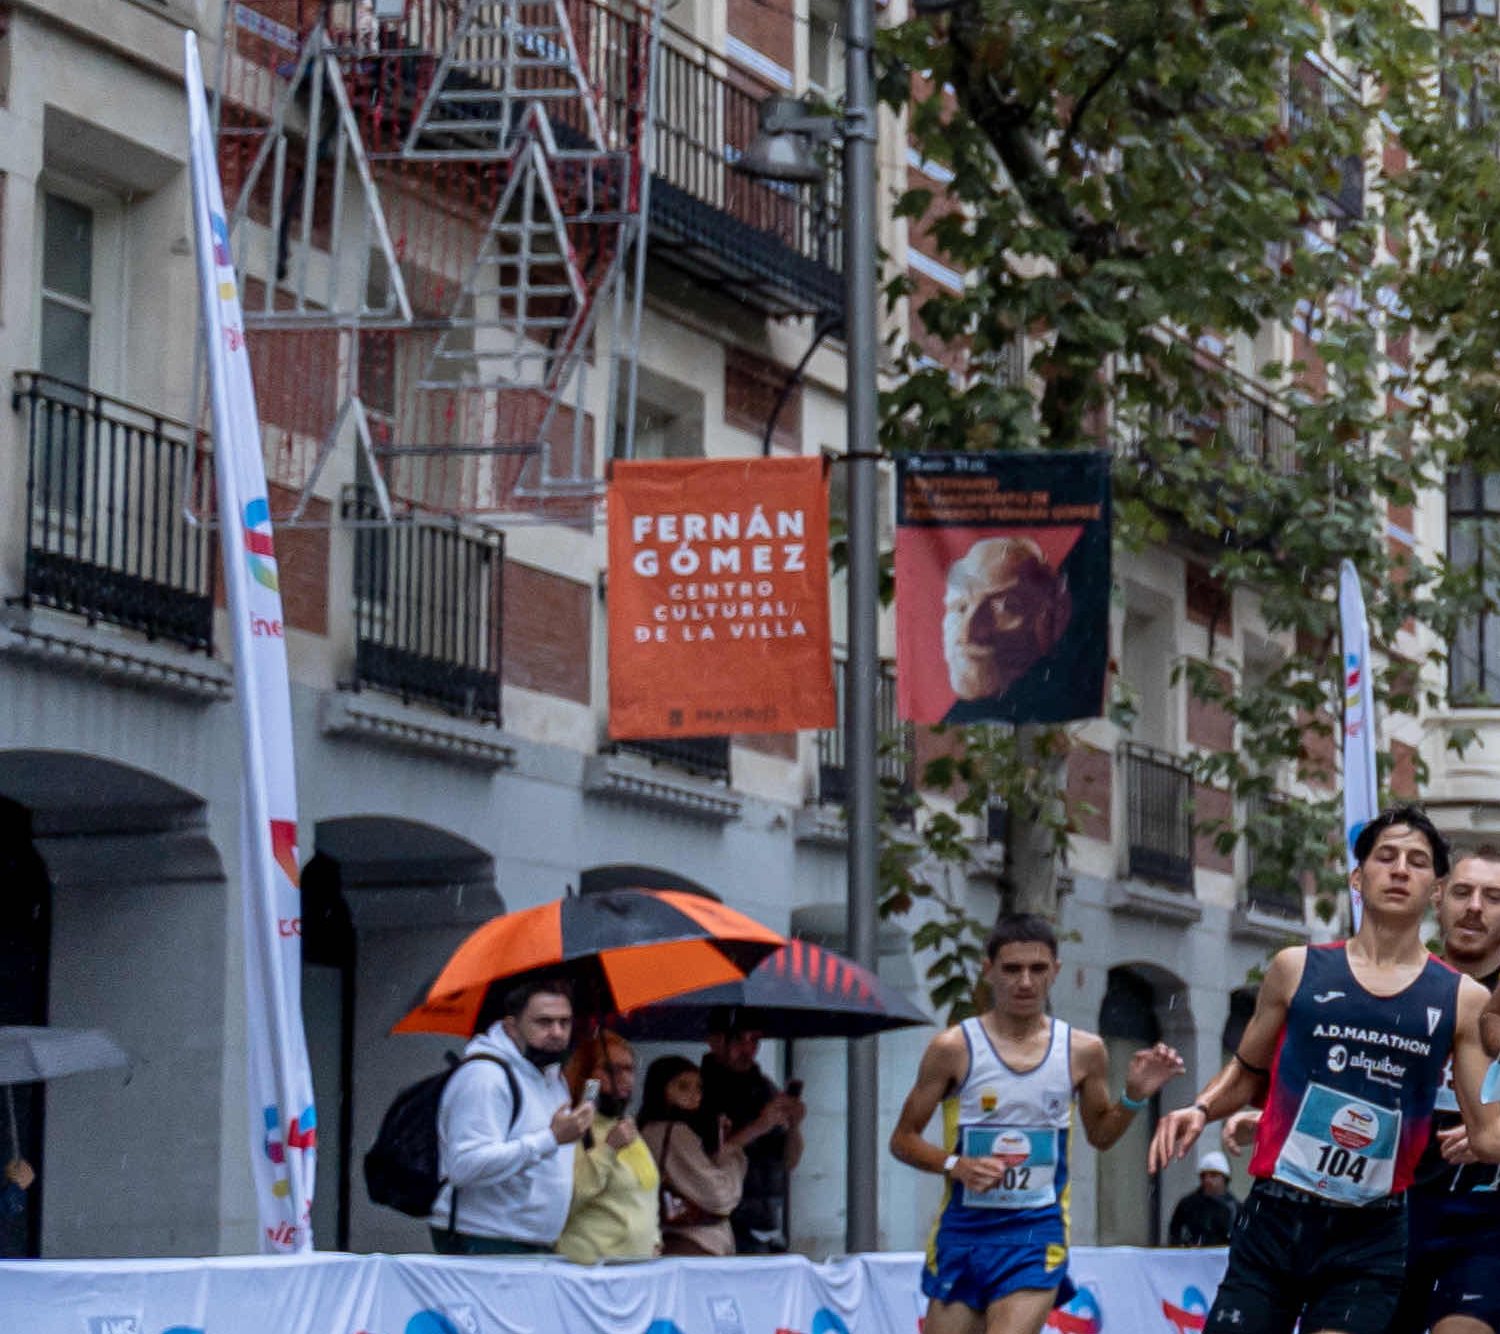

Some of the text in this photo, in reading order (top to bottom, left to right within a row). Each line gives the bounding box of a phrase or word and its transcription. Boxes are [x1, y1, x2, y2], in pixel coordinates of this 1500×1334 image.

[632, 504, 806, 544] FERNÁN
[632, 540, 806, 578] GÓMEZ
[668, 580, 774, 600] CENTRO
[634, 620, 807, 643] DE LA VILLA
[1312, 1023, 1431, 1056] A.D.MARATHON
[1001, 1167, 1031, 1191] 02
[1316, 1144, 1369, 1184] 104
